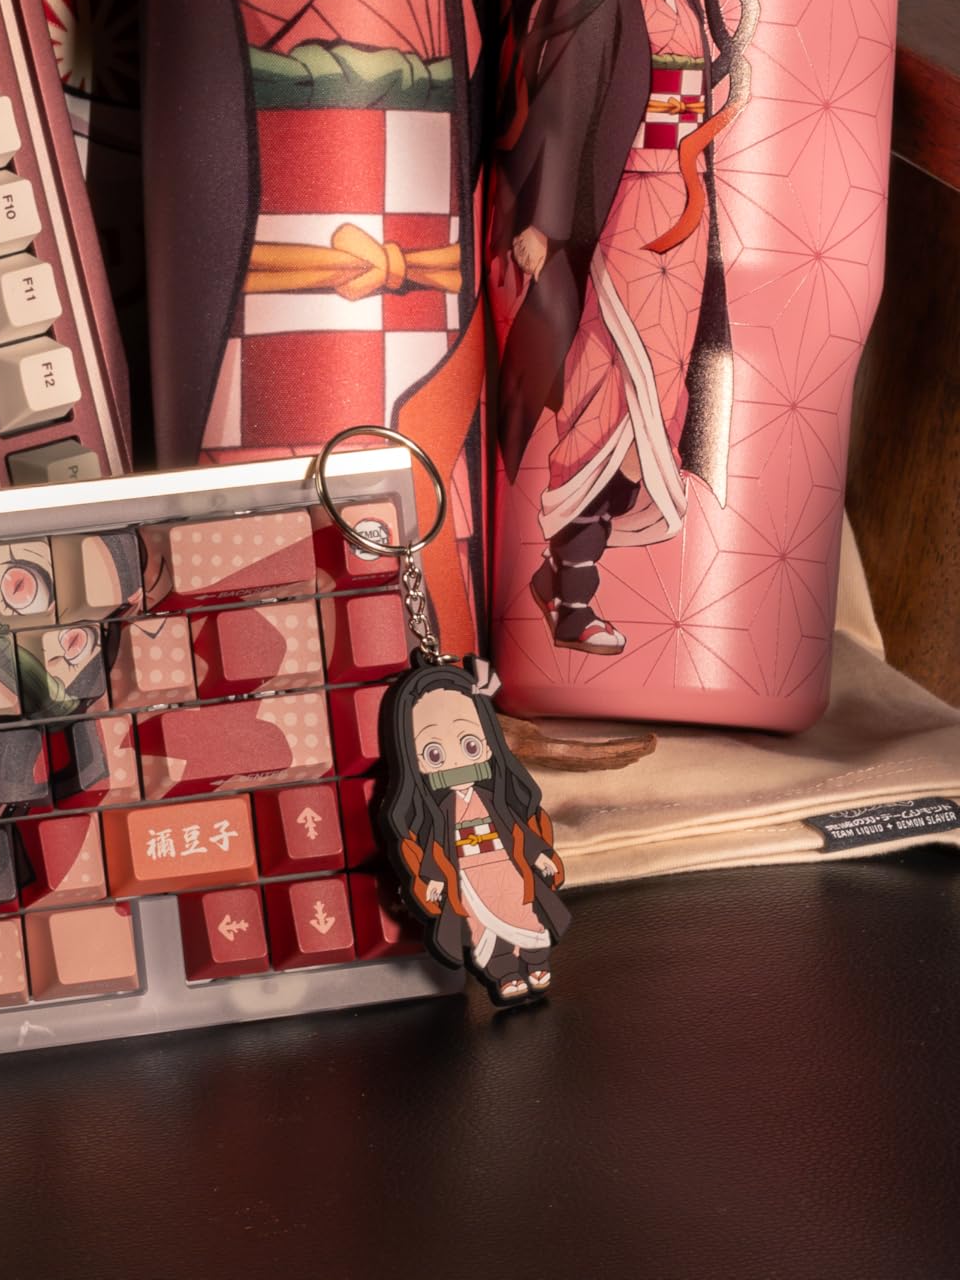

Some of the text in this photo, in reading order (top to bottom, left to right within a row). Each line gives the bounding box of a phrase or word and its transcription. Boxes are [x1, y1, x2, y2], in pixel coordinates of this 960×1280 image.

[1, 193, 17, 221] F10
[21, 276, 37, 302] F11
[41, 361, 56, 389] F12
[831, 829, 855, 839] TEAM
[856, 824, 884, 836] LIQUID
[896, 817, 925, 830] DEMON
[926, 811, 958, 826] SLAYER
